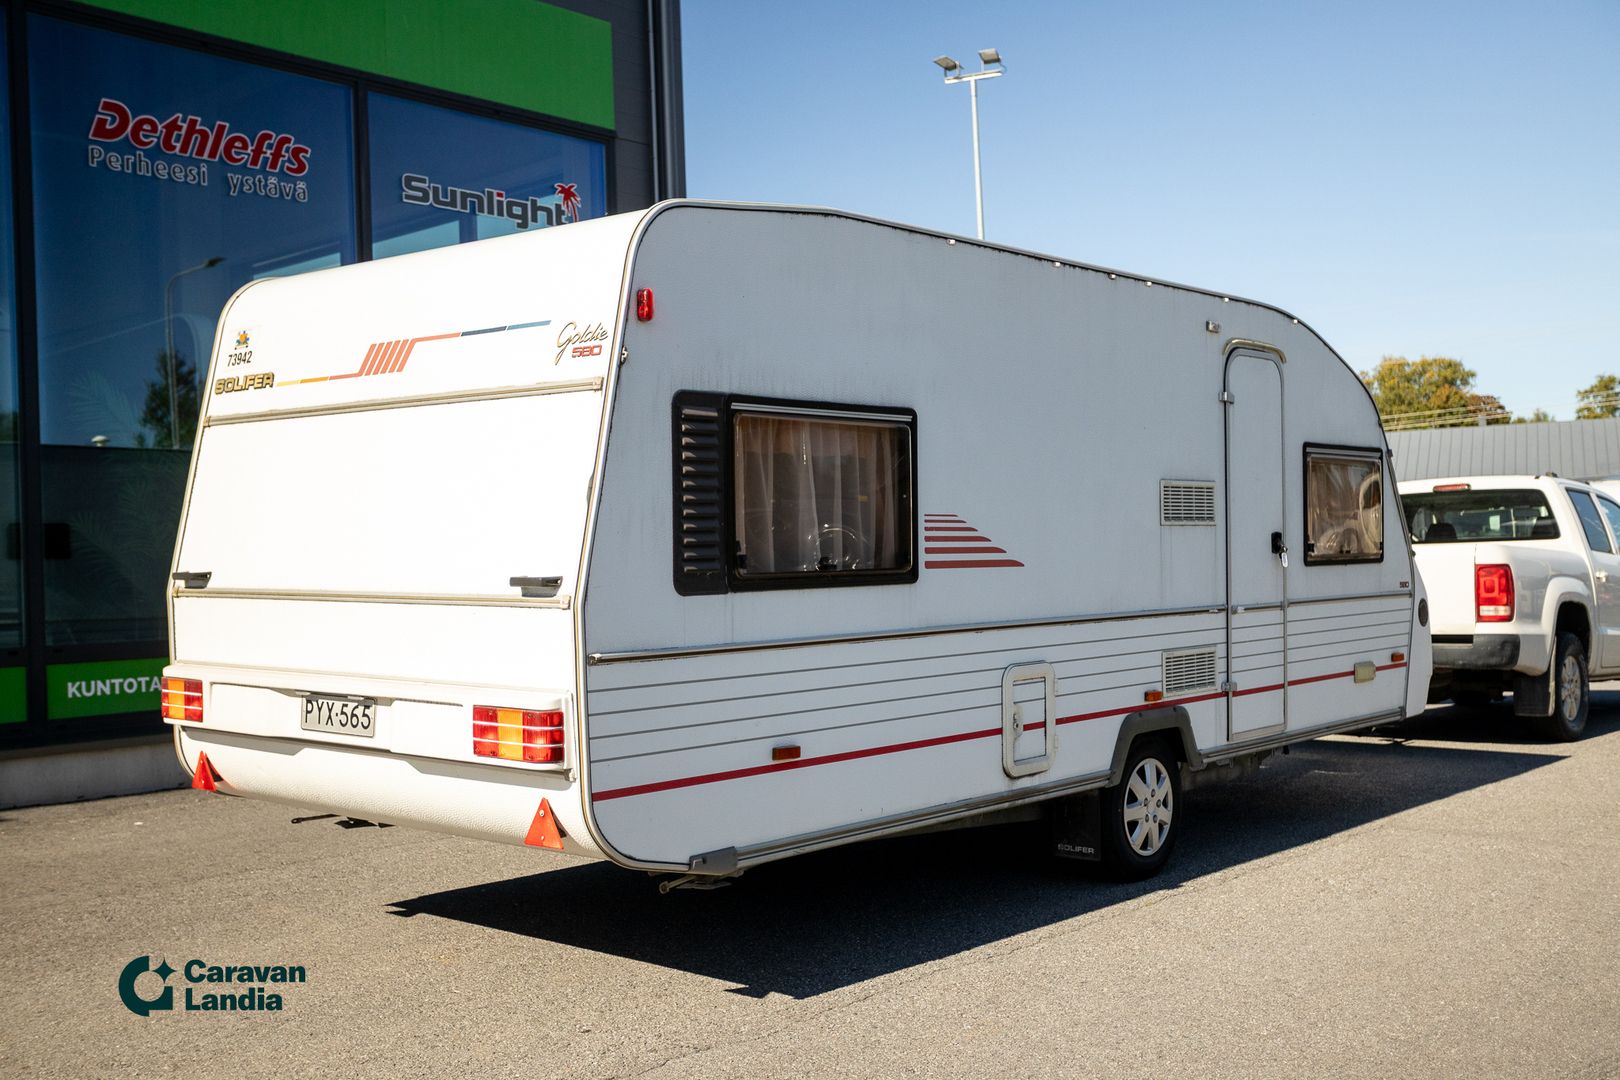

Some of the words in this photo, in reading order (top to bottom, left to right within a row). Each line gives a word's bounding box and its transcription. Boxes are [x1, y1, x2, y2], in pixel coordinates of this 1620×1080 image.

[89, 98, 311, 176] Dethleffs
[88, 145, 208, 186] Perheesi
[227, 172, 308, 202] ystävä
[402, 173, 568, 229] Sunlight
[227, 350, 253, 367] 73942
[555, 321, 609, 365] Goldie
[571, 344, 603, 358] 580
[215, 371, 275, 395] SOLIFER
